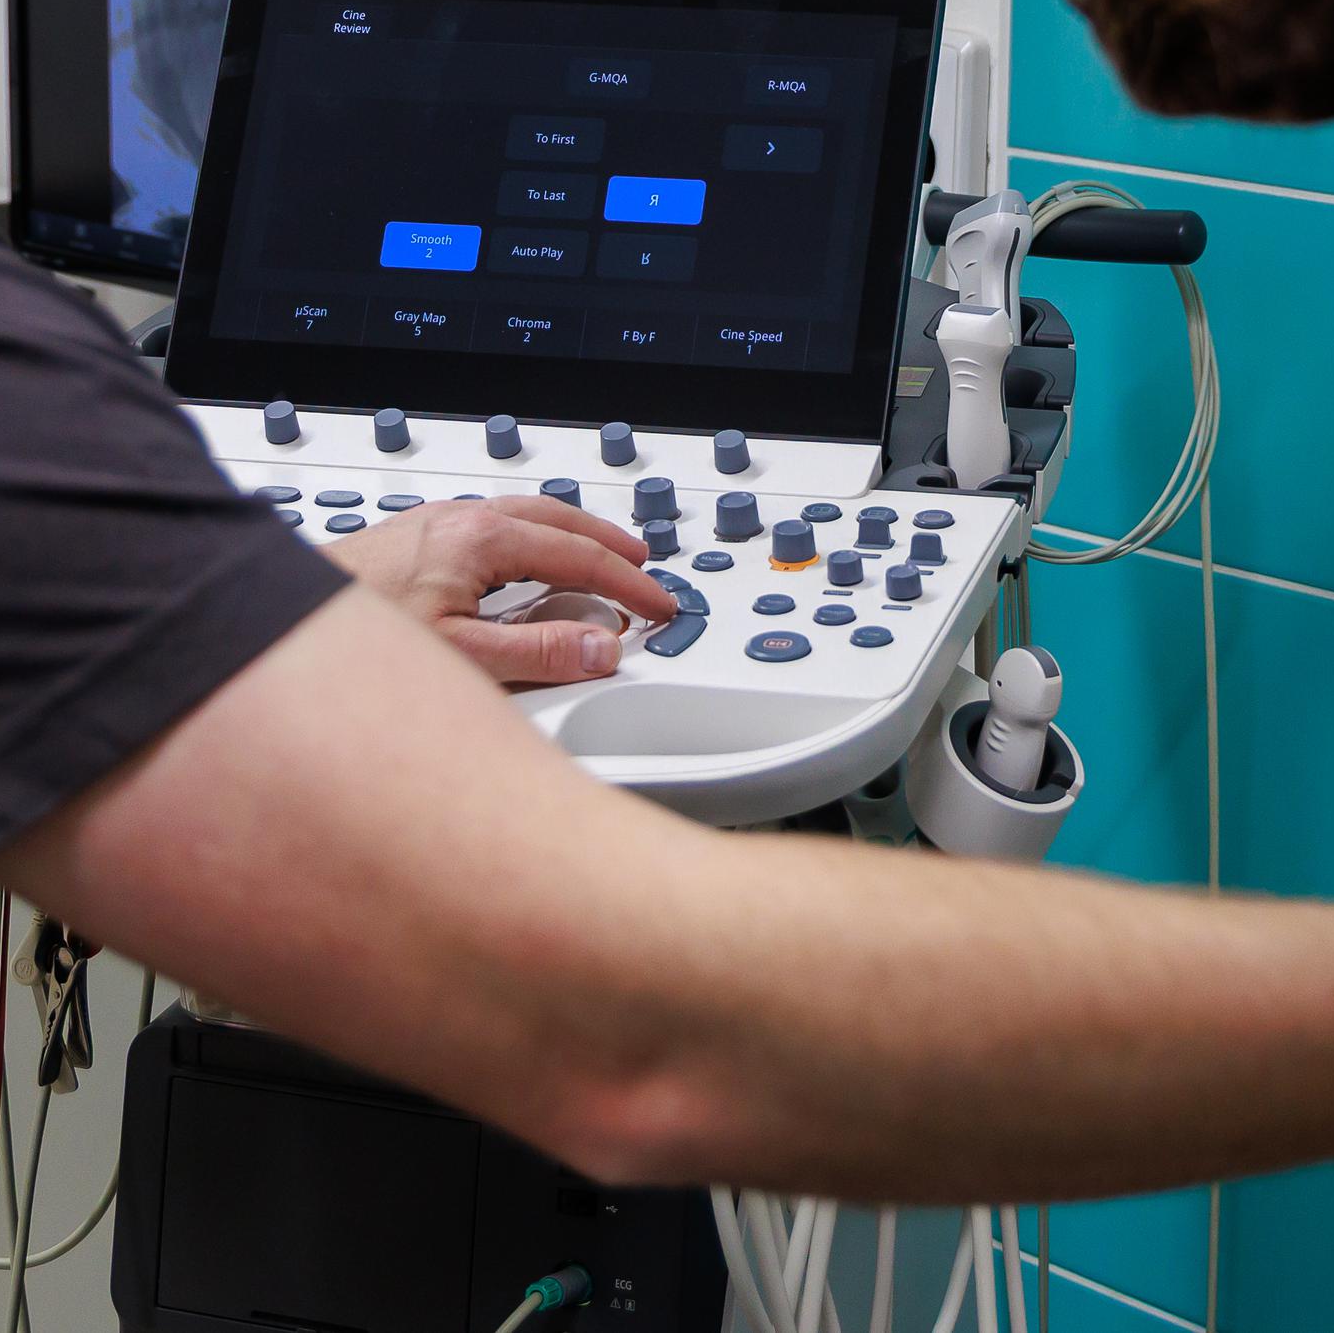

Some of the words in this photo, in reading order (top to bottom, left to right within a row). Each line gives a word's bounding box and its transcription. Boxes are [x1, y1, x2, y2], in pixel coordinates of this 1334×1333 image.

[342, 9, 366, 21] Cine
[333, 22, 371, 35] Review
[589, 72, 628, 86] G-MQA
[767, 80, 806, 94] R-MQA
[535, 132, 549, 145] To
[552, 133, 575, 145] First
[527, 189, 541, 201] To
[543, 190, 566, 201] Last
[410, 233, 453, 246] Smooth
[425, 248, 433, 259] 2
[511, 245, 538, 257] Auto
[540, 246, 564, 261] Play
[394, 310, 420, 324] Gray
[422, 312, 447, 325] Map
[507, 317, 552, 330] Chroma
[306, 319, 314, 330] 7
[414, 325, 422, 336] 5
[523, 331, 531, 343] 2
[622, 330, 630, 341] F
[632, 331, 647, 345] By
[648, 331, 657, 342] F
[720, 328, 746, 341] Cine
[748, 330, 783, 345] Speed
[746, 344, 752, 355] 1
[614, 1278, 633, 1291] ECG
